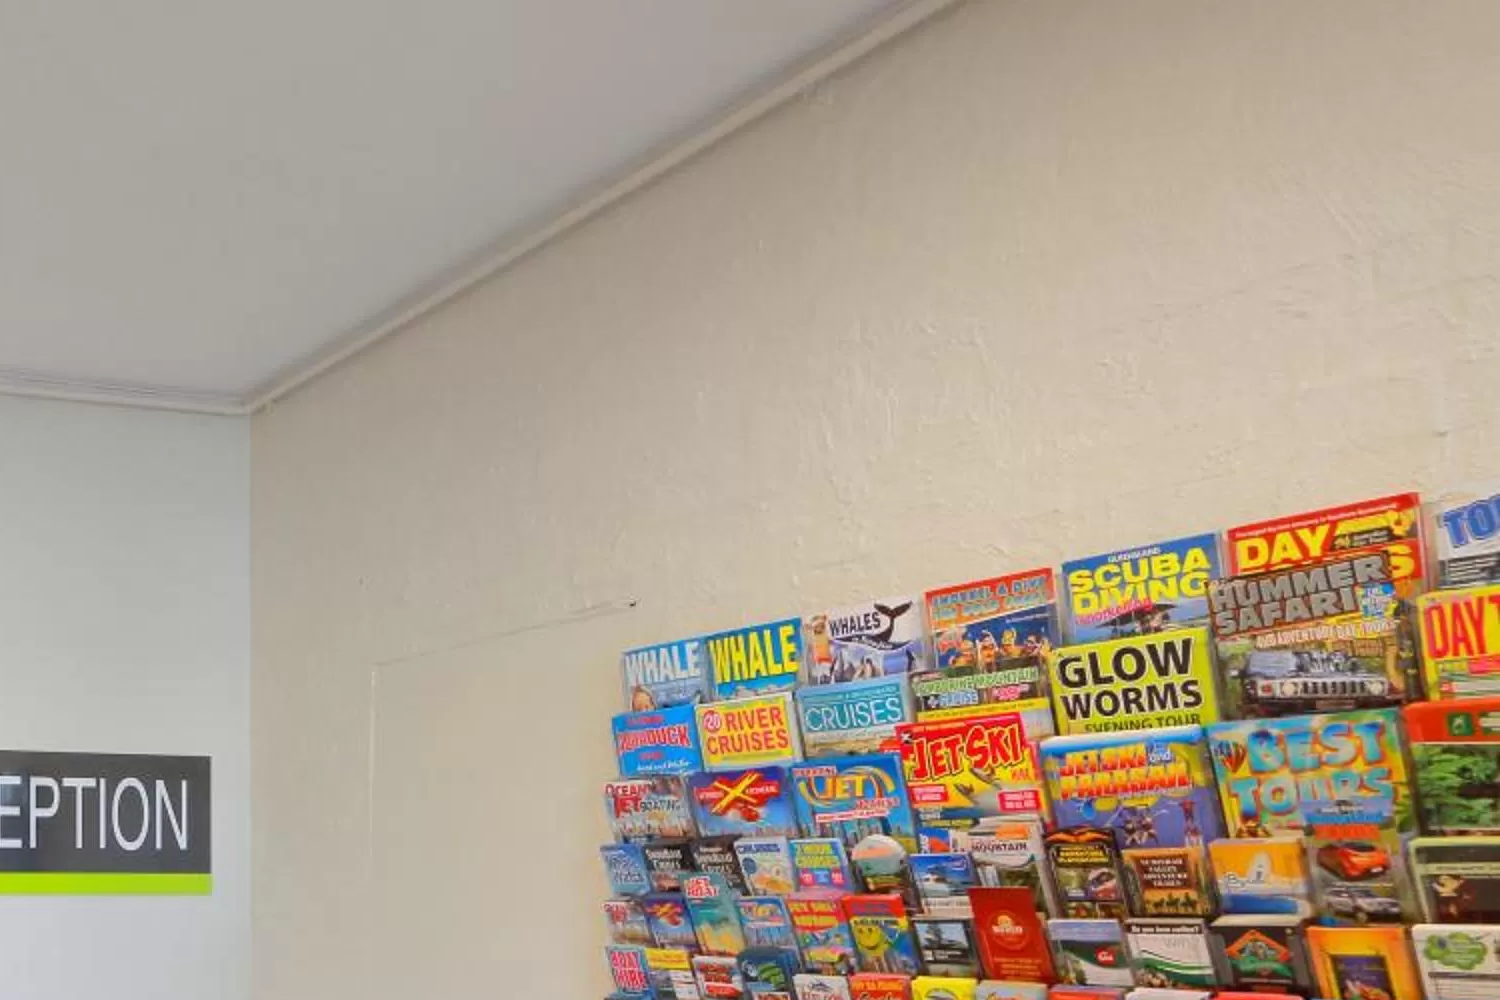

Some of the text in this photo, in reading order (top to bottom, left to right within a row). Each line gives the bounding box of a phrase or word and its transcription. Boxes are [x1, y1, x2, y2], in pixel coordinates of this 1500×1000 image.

[1444, 494, 1500, 546] TO
[1235, 523, 1330, 570] DAY
[1068, 548, 1211, 593] SCUBA
[1071, 572, 1210, 615] DIVING
[1212, 554, 1392, 612] HUMMER
[829, 611, 881, 637] WHALES
[1217, 588, 1356, 636] SAFARI
[1425, 597, 1485, 658] DAY
[623, 641, 700, 685] WHALE
[708, 623, 798, 685] WHALE
[1058, 638, 1192, 689] GLOW
[724, 706, 784, 732] RIVER
[804, 697, 902, 732] CRUISES
[1061, 679, 1203, 720] WORMS
[1156, 713, 1200, 726] TOUR
[707, 728, 789, 755] CRUISES
[1247, 720, 1384, 773] BEST
[1230, 768, 1395, 820] TOURS
